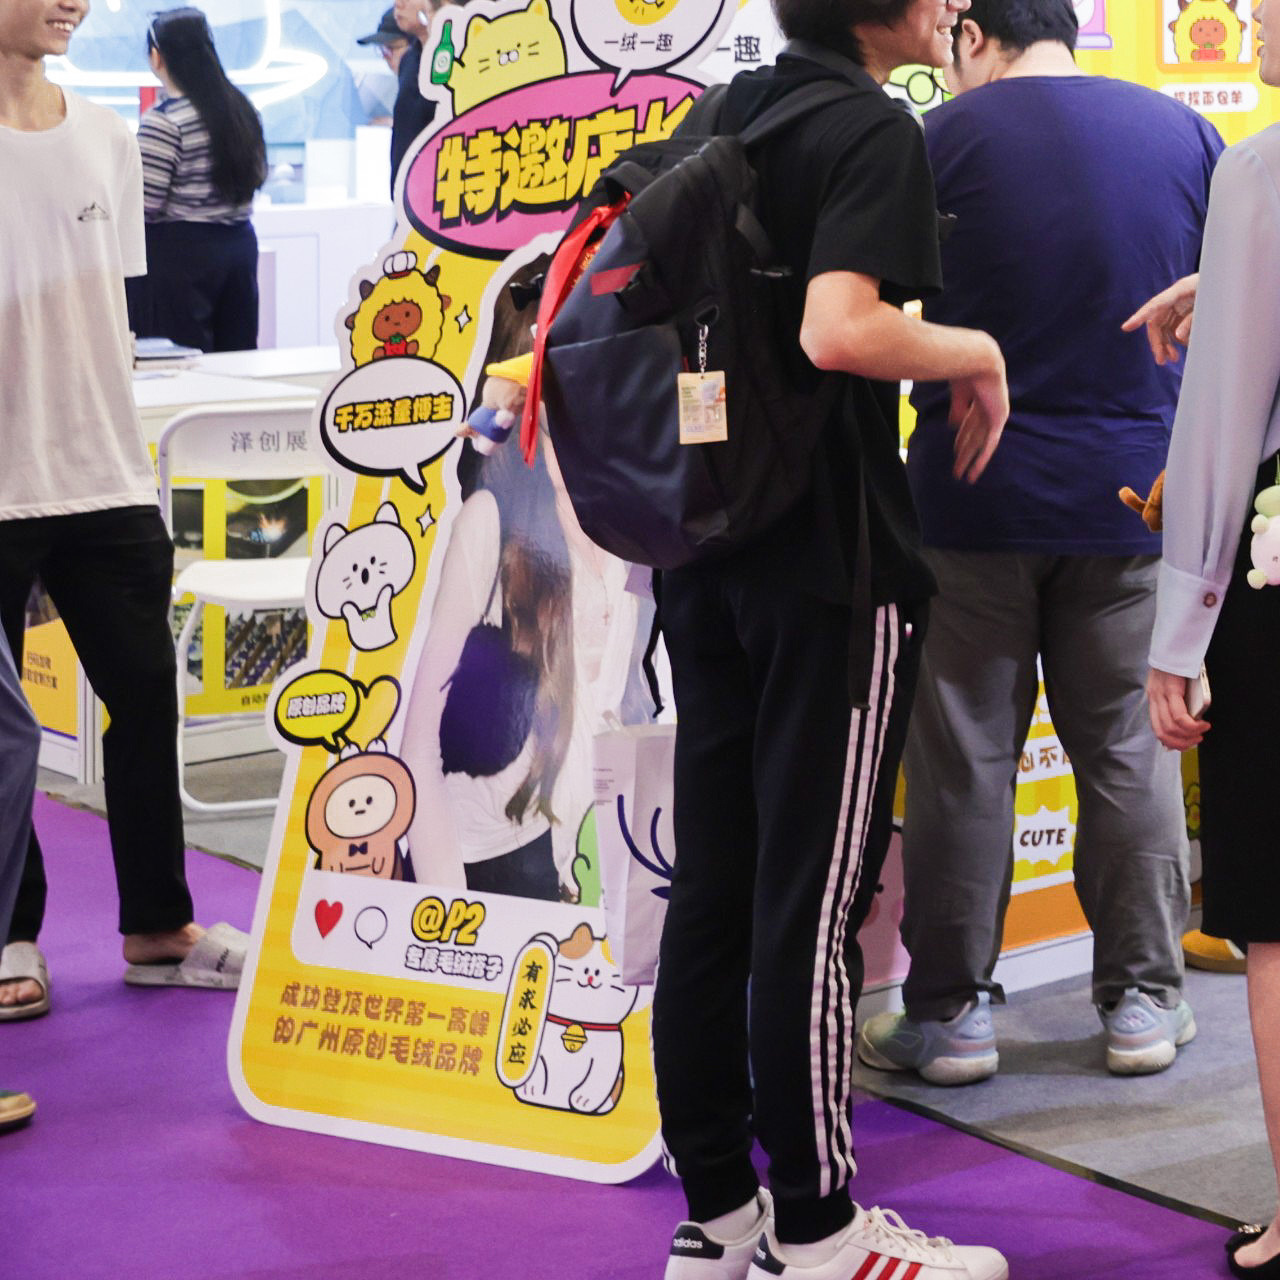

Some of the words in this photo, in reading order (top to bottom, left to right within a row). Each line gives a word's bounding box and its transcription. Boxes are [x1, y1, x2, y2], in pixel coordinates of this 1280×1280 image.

[604, 32, 673, 54] 一绒一趣
[334, 391, 453, 434] 千万流量博主
[231, 428, 309, 453] 泽创展
[286, 691, 346, 718] 原创品牌
[1019, 828, 1067, 848] CUTE
[411, 894, 487, 945] @P2
[405, 946, 504, 981] 专属毛绒搭子
[505, 960, 543, 1067] 有求必应
[272, 1015, 484, 1078] 的广州原创毛绒品牌
